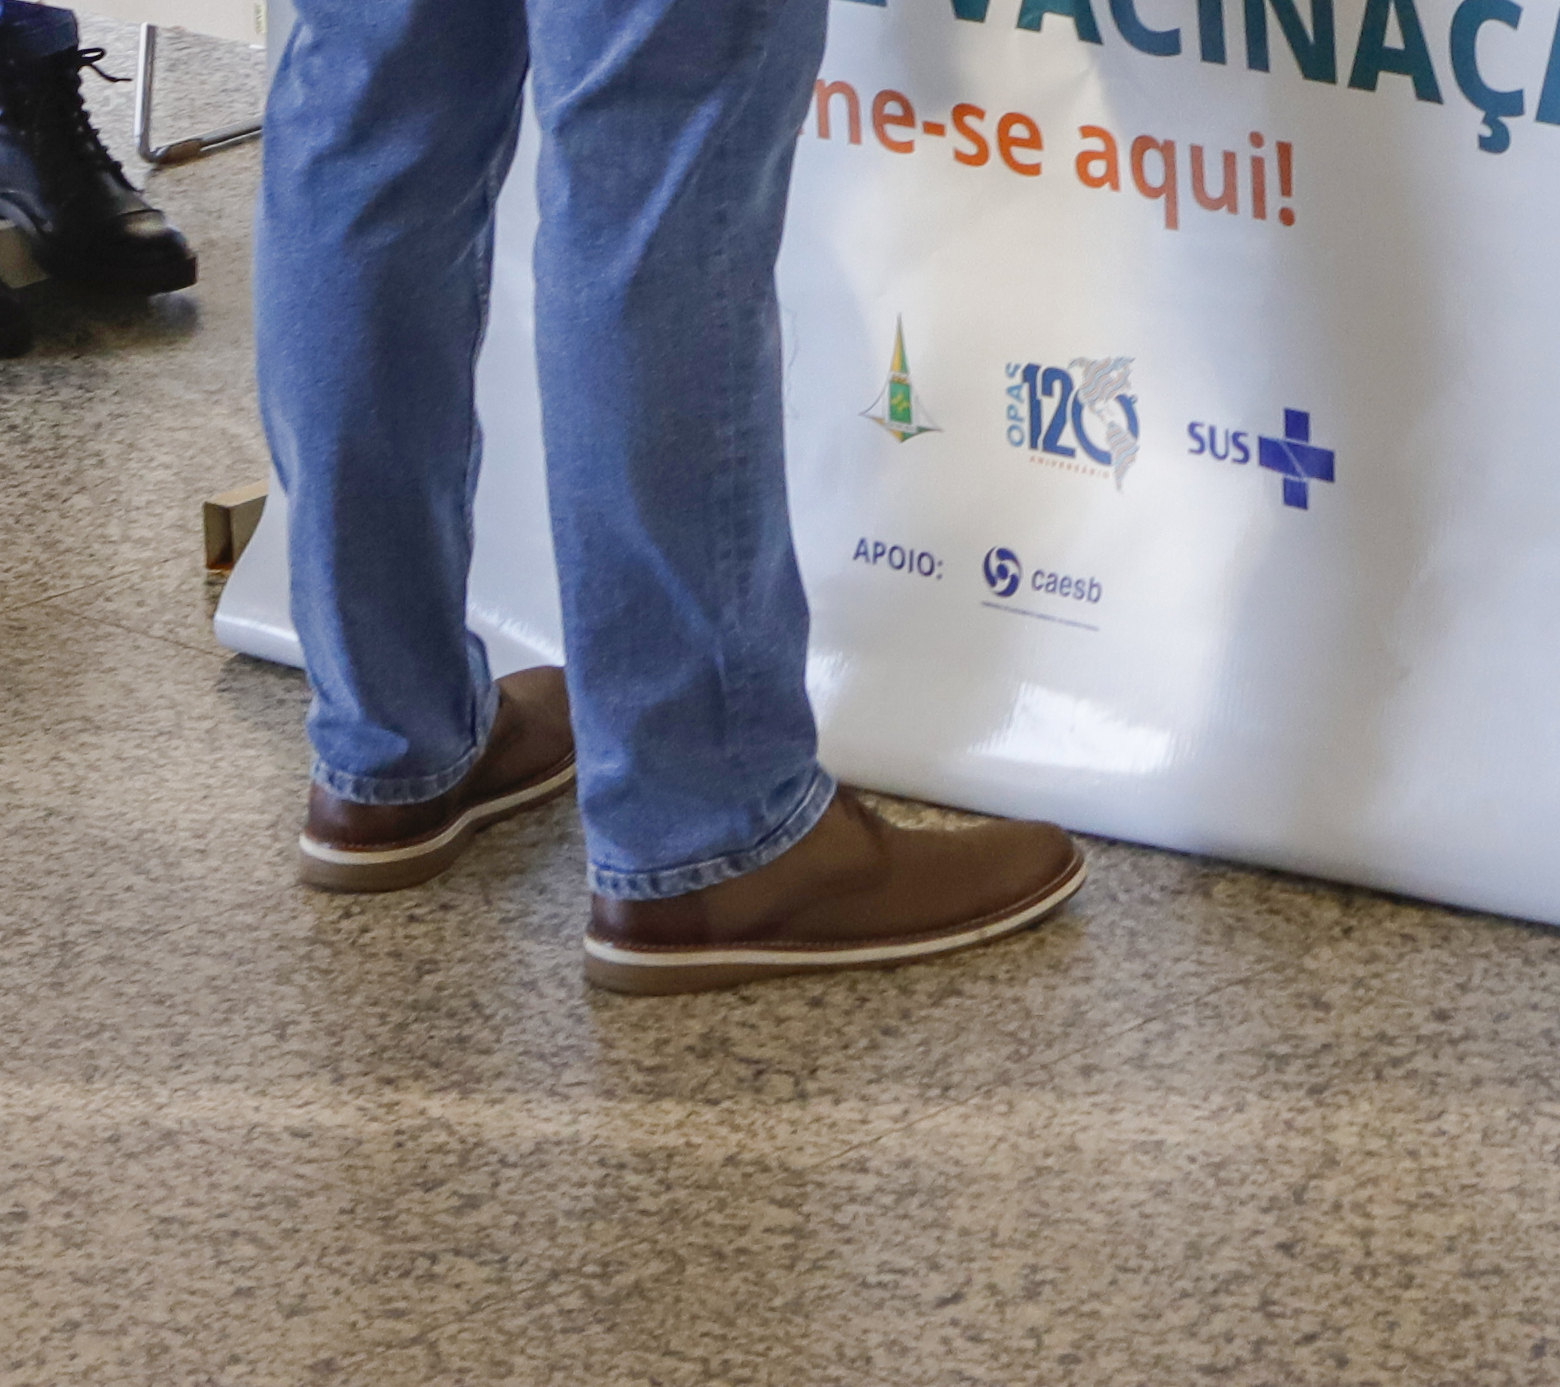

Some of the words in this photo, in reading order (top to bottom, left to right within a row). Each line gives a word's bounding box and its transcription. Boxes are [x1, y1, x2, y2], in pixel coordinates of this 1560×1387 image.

[1074, 123, 1297, 230] aqui!
[1005, 361, 1026, 449] OPAS
[1187, 421, 1252, 466] SUS
[852, 537, 944, 581] APOIO:
[1031, 568, 1103, 604] caesb
